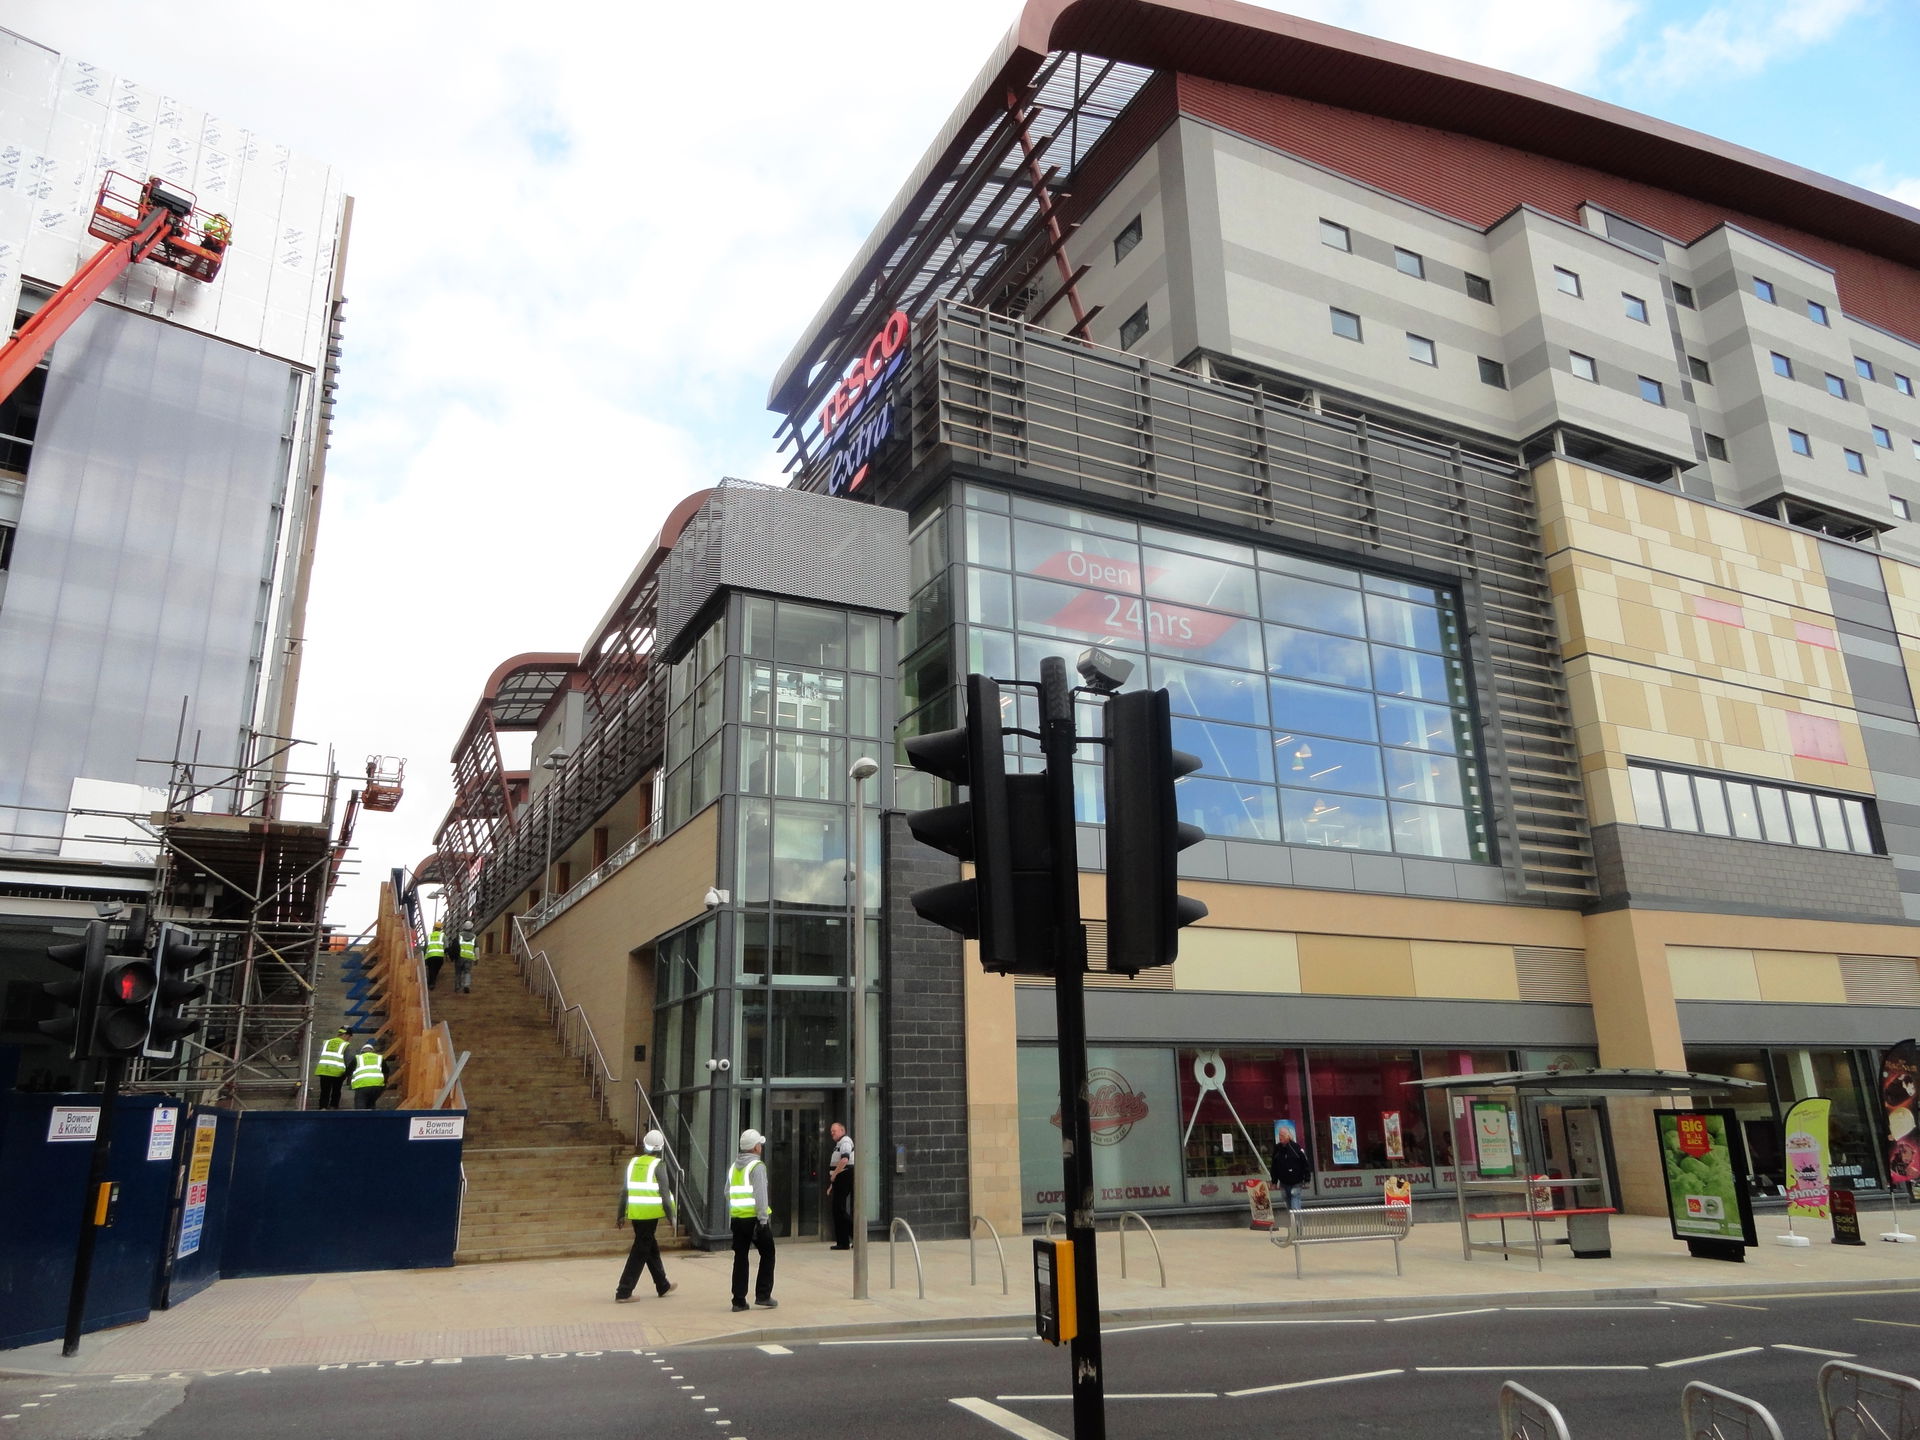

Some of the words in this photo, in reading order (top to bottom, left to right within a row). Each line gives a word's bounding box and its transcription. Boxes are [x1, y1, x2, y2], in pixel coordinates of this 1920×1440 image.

[818, 311, 909, 438] TESCO
[829, 402, 894, 496] extra
[1067, 553, 1132, 586] Open
[1103, 594, 1194, 640] 24hrs
[66, 1113, 94, 1123] Bowmer
[64, 1123, 92, 1134] Kirkland
[425, 1127, 454, 1135] Kirkland
[1681, 1119, 1703, 1131] BIG
[1324, 1176, 1362, 1188] COFFEE
[1036, 1191, 1065, 1204] COF
[1101, 1187, 1123, 1201] ICE
[1125, 1185, 1171, 1199] CREAM
[1788, 1188, 1828, 1200] shmoo
